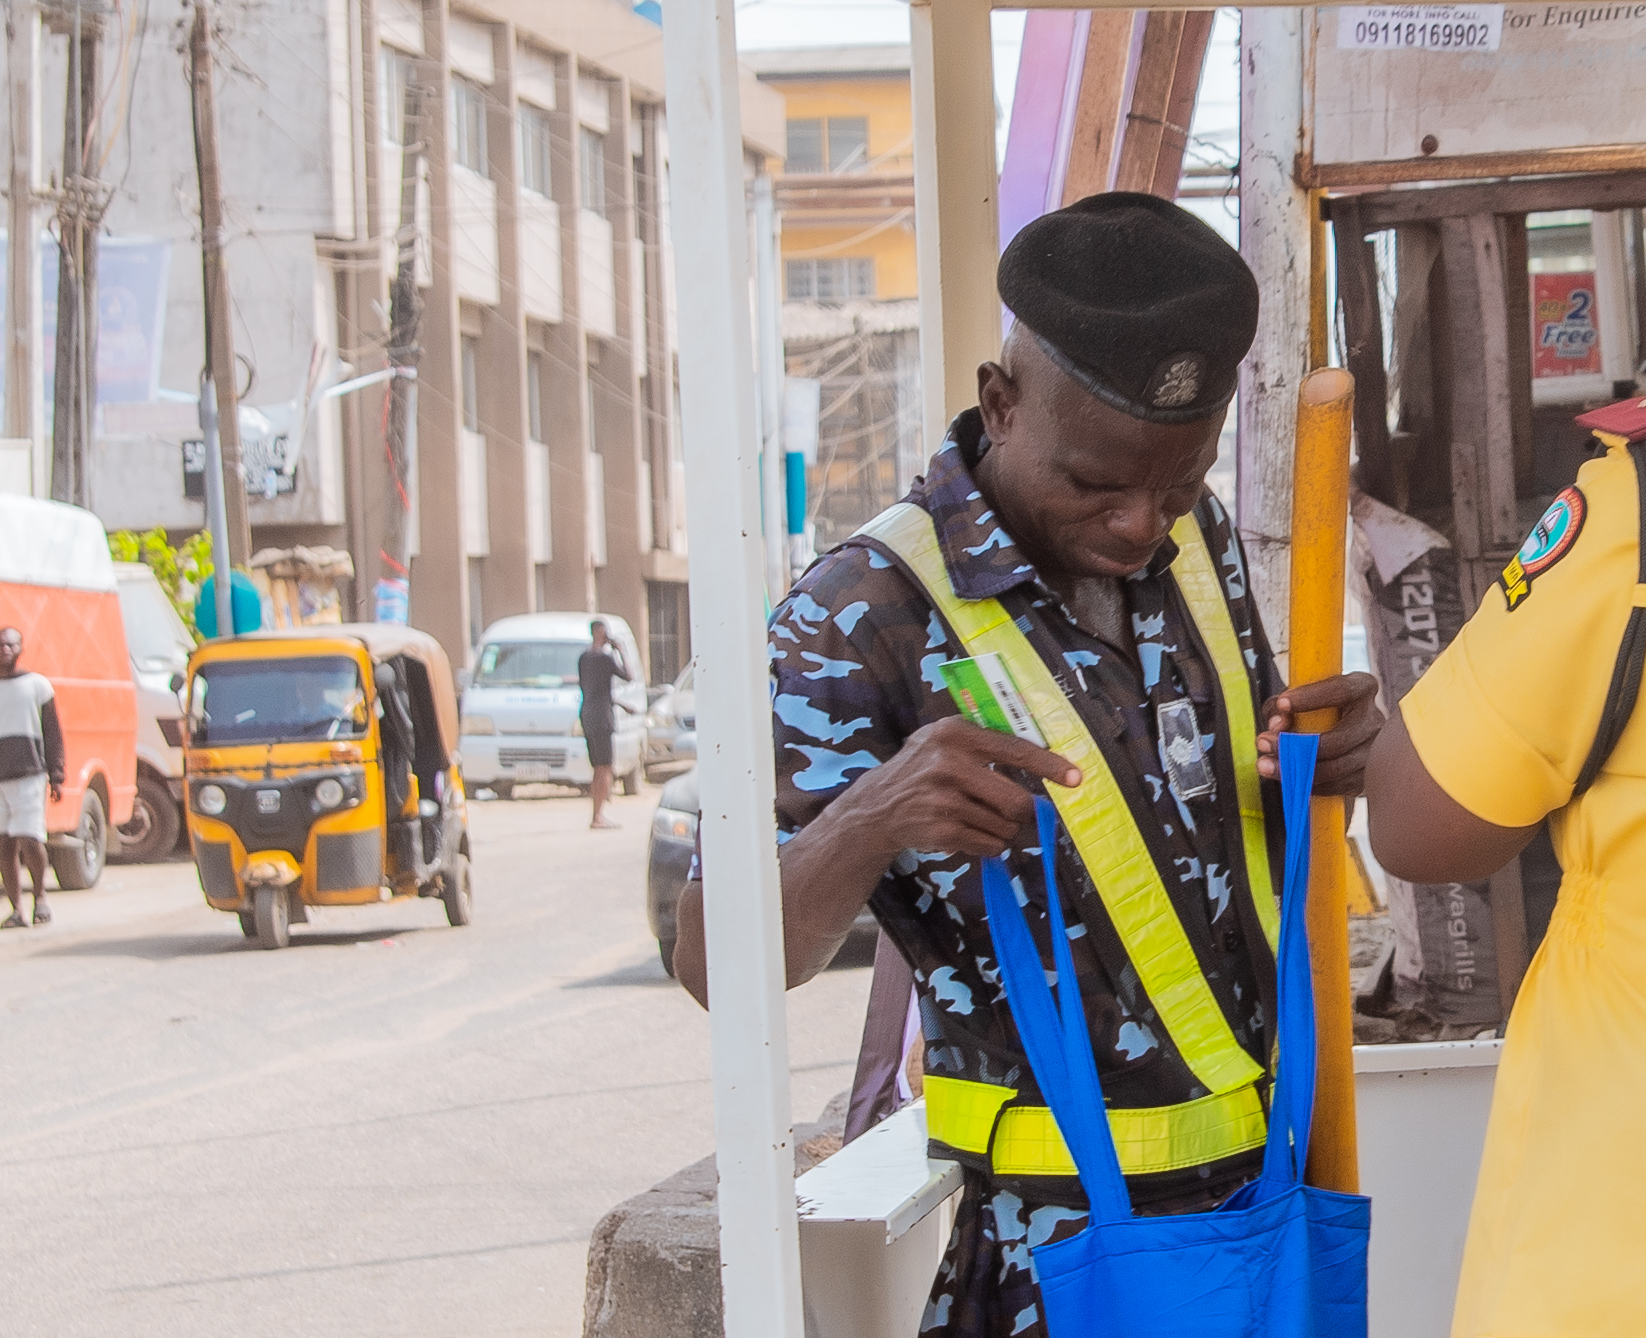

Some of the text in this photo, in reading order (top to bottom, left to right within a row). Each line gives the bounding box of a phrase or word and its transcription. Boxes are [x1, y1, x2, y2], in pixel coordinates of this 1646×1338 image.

[1355, 21, 1489, 47] 09118169902
[1566, 291, 1591, 320] 2
[1542, 325, 1595, 343] Free
